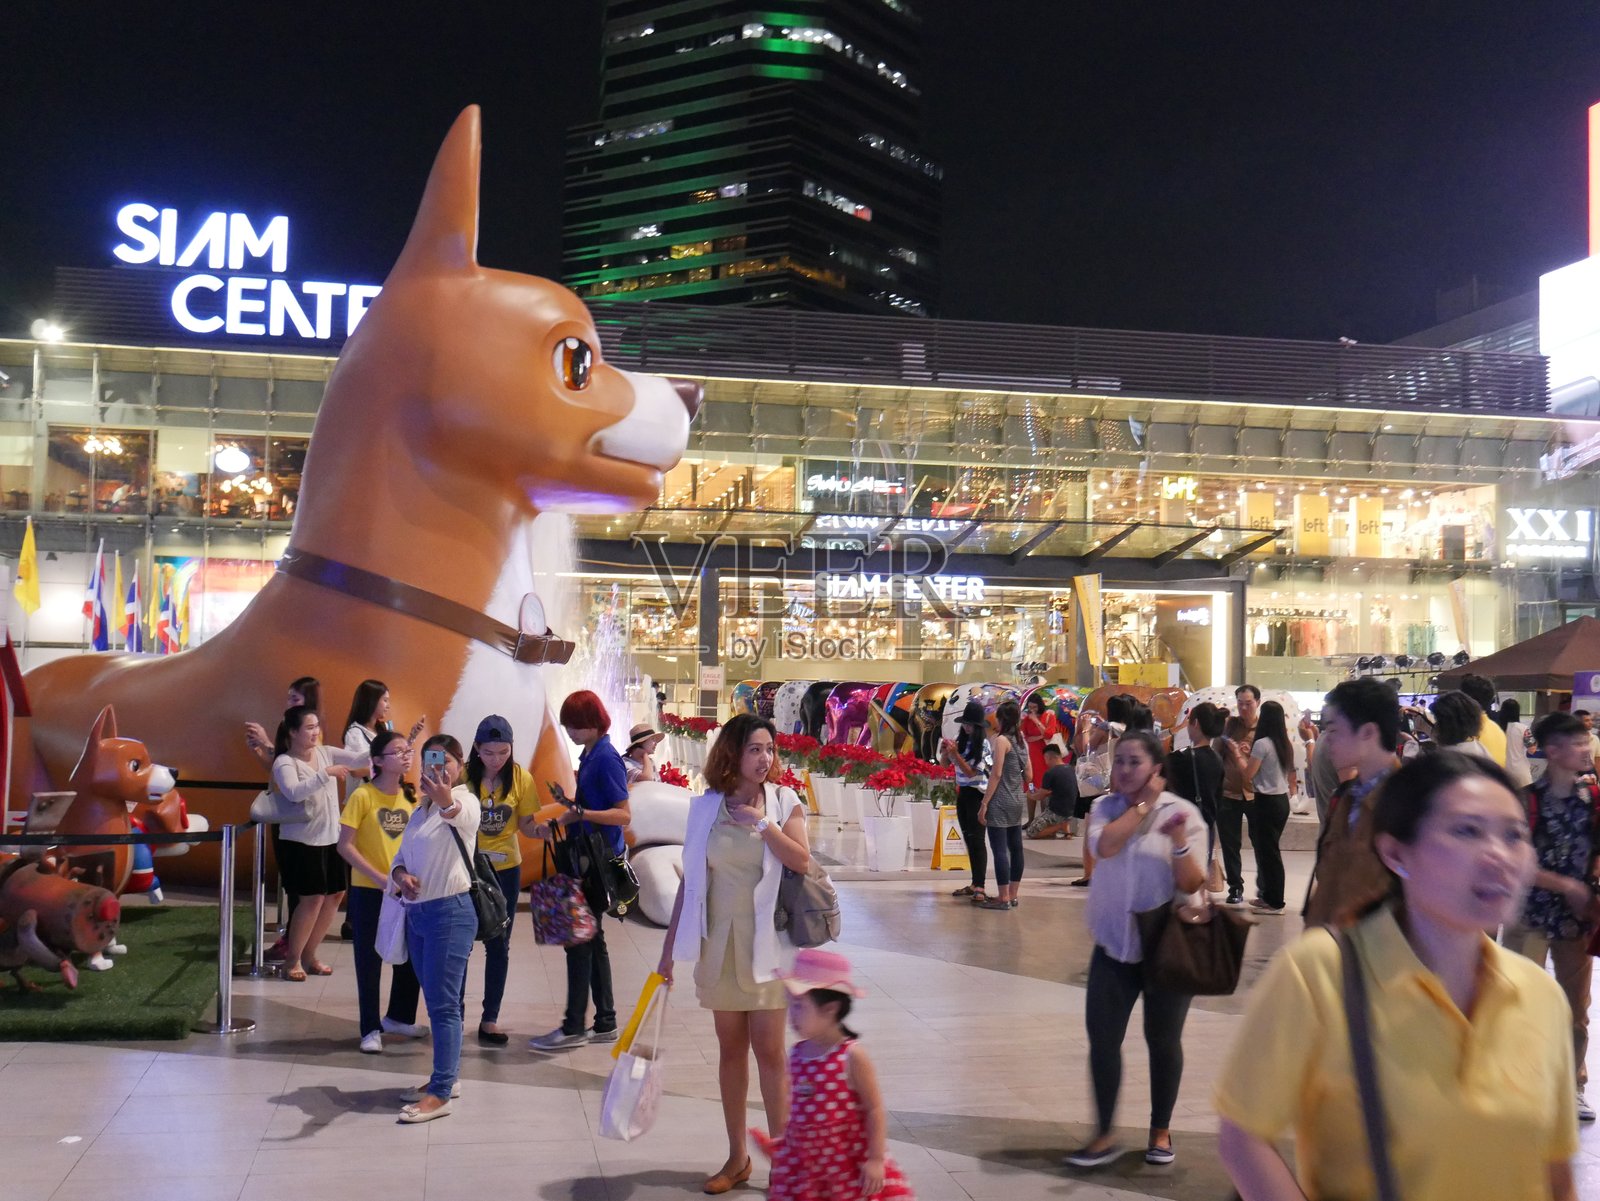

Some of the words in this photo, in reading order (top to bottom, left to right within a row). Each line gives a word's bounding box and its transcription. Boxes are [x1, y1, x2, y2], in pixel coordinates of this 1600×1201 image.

[112, 202, 289, 273] SIAM
[171, 273, 384, 339] CENTE
[1505, 507, 1591, 542] XXI
[815, 572, 880, 598] SIAM
[889, 574, 985, 601] CENTER
